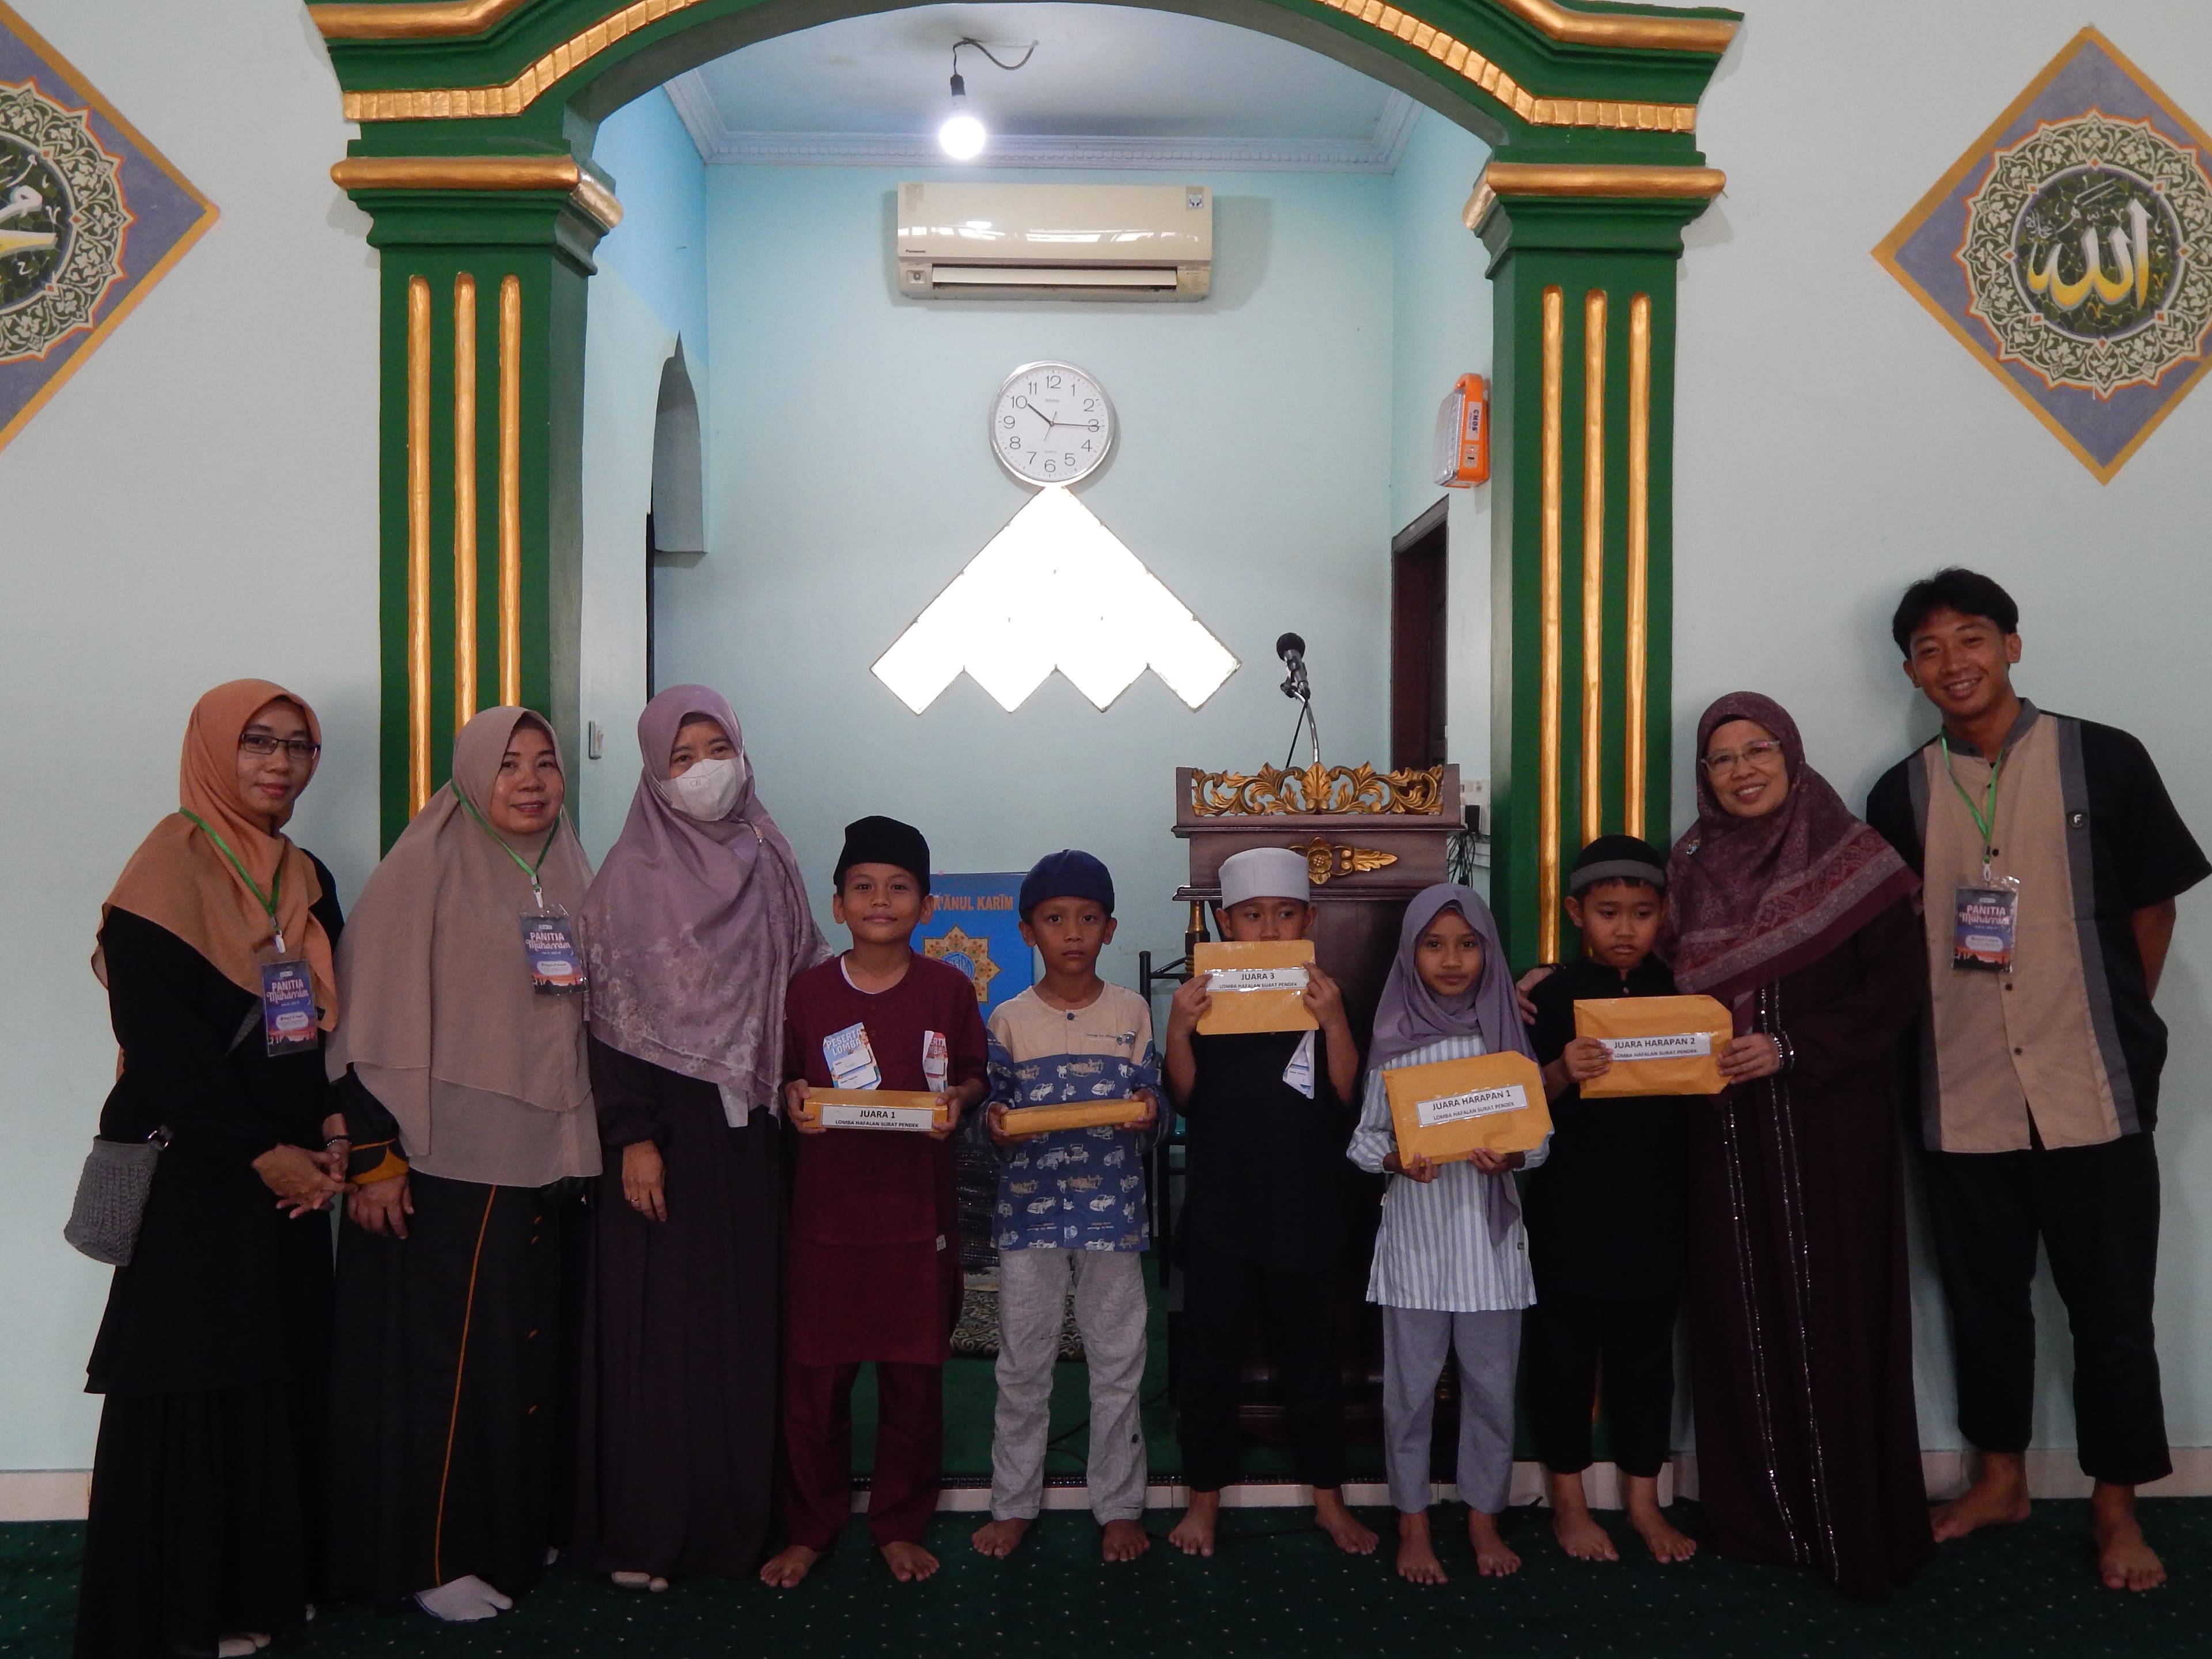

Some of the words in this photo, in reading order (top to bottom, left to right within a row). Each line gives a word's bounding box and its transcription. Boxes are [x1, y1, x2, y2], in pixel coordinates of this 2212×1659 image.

[1028, 382, 1037, 395] 11
[1046, 375, 1061, 389] 12
[1071, 384, 1075, 396] 1
[1011, 396, 1028, 409] 10
[1084, 399, 1094, 412] 2
[1003, 415, 1016, 429] 9
[1088, 419, 1100, 432] 3
[1009, 436, 1021, 449] 8
[1081, 439, 1092, 452] 4
[1027, 452, 1037, 465] 7
[1065, 453, 1075, 467] 5
[1044, 459, 1056, 472] 6
[2074, 813, 2082, 824] F
[933, 893, 974, 911] R'ĀNUL
[1966, 904, 2006, 916] PANITIA
[530, 932, 565, 941] PANITIA
[525, 939, 571, 952] Muharram
[271, 979, 304, 991] PANITIA
[267, 990, 309, 1004] Muharram
[827, 1028, 862, 1050] PESERTA
[1614, 1040, 1642, 1049] JUARA
[1645, 1037, 1688, 1047] HARAPAN
[832, 1037, 861, 1056] LOMBA
[1433, 1100, 1460, 1111] JUARA
[1462, 1092, 1504, 1105] HARAPAN
[859, 1109, 888, 1118] JUARA
[1433, 1113, 1452, 1121] LOMBA
[1453, 1109, 1477, 1118] HAFALAN
[1478, 1105, 1494, 1113] SURAT
